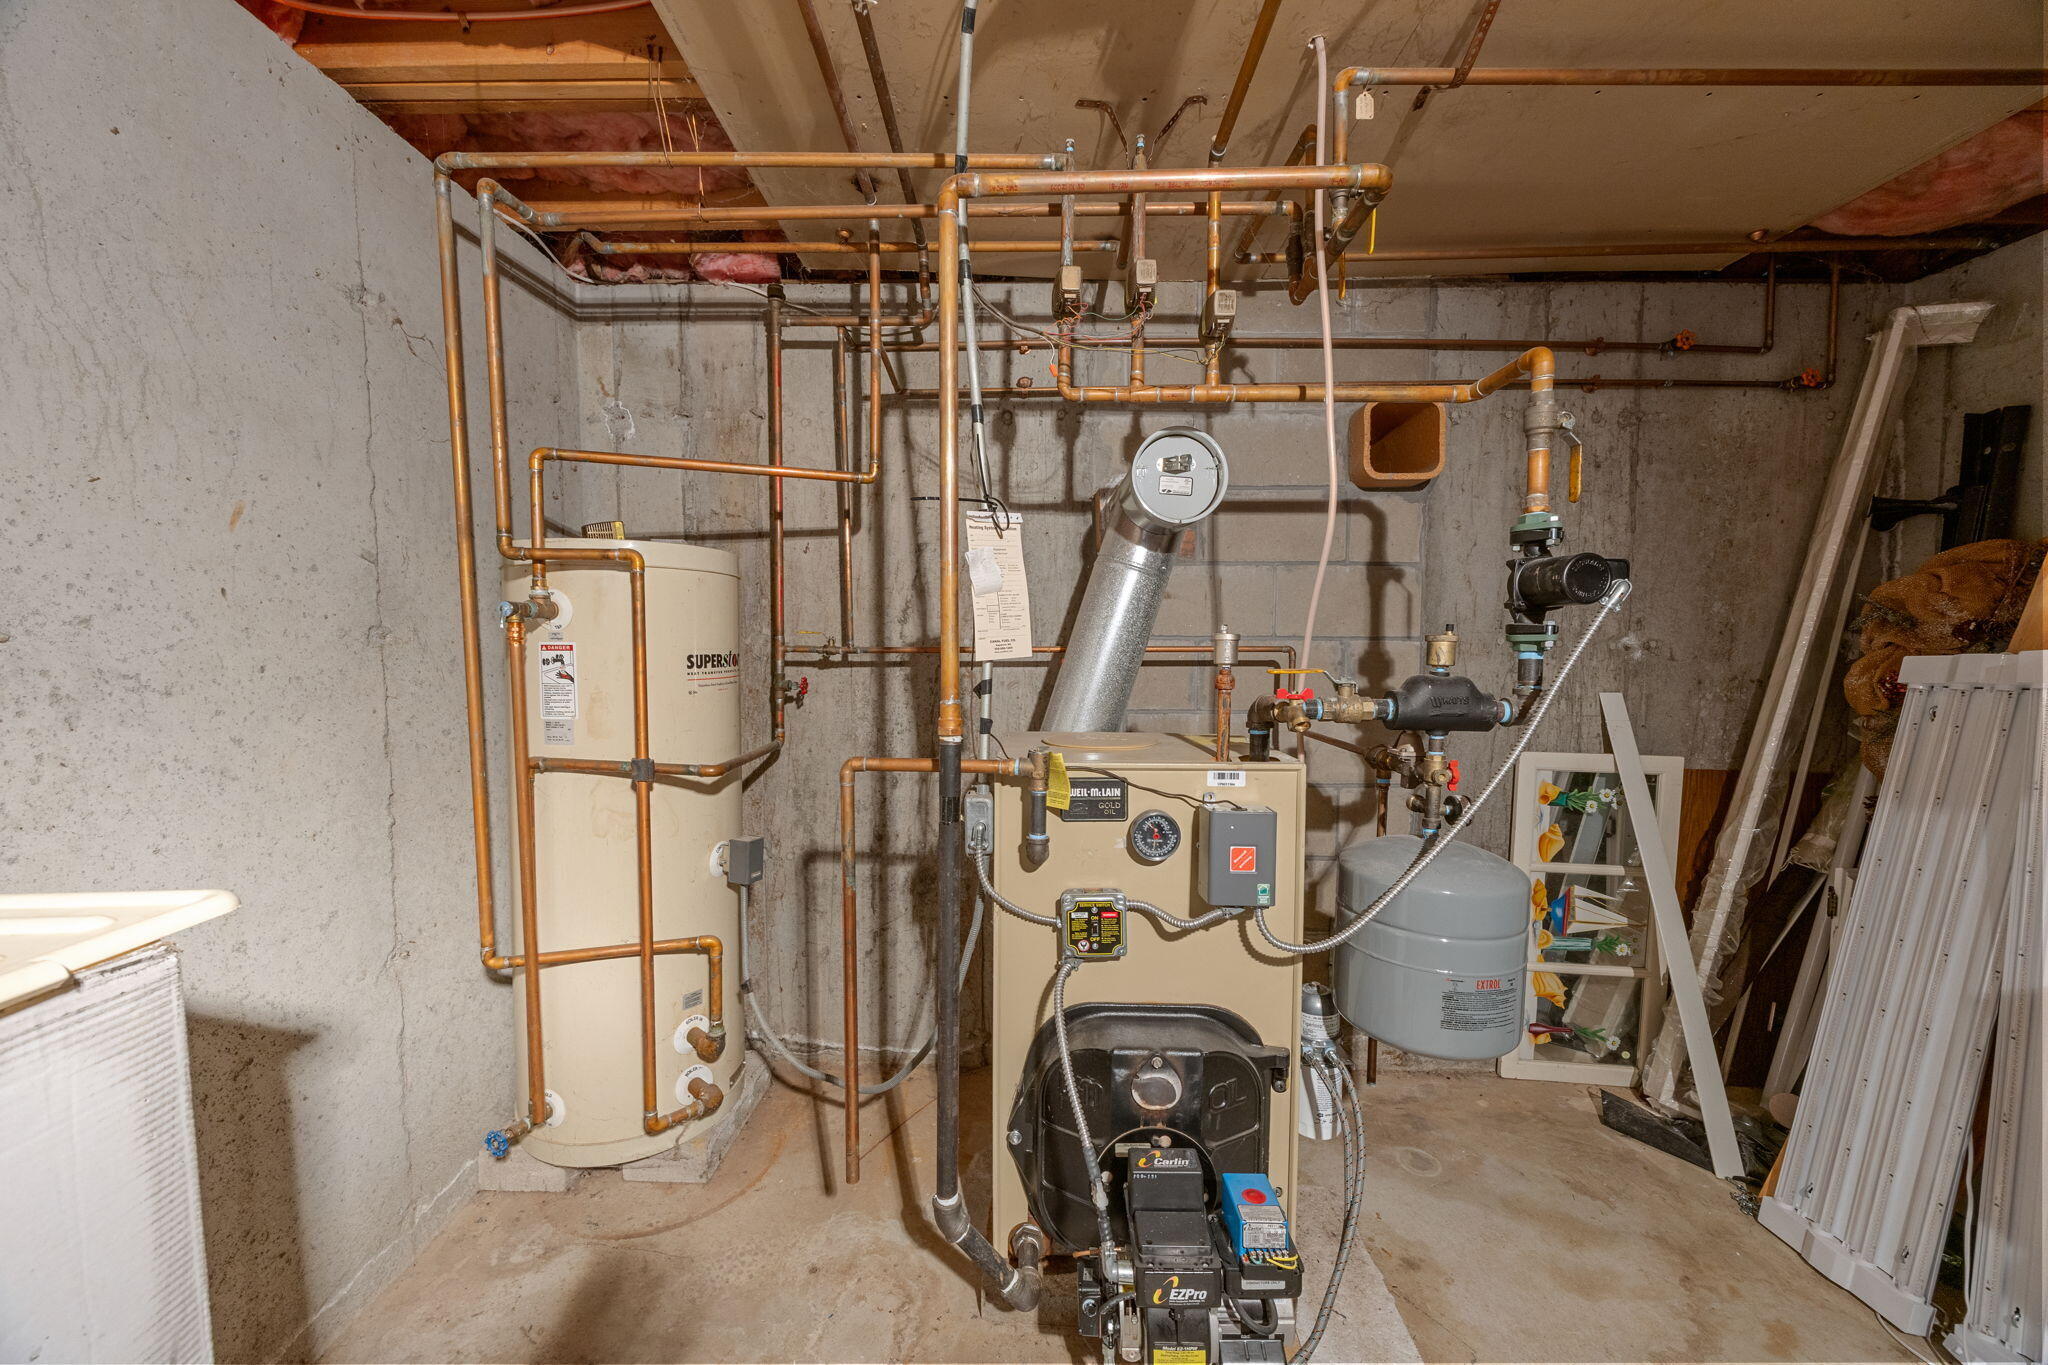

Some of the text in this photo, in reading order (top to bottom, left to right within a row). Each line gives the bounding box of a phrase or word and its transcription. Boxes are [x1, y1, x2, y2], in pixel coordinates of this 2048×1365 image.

[1476, 979, 1501, 990] EXTROL
[1154, 1158, 1189, 1167] Carlin
[1169, 1288, 1207, 1300] EZPro
